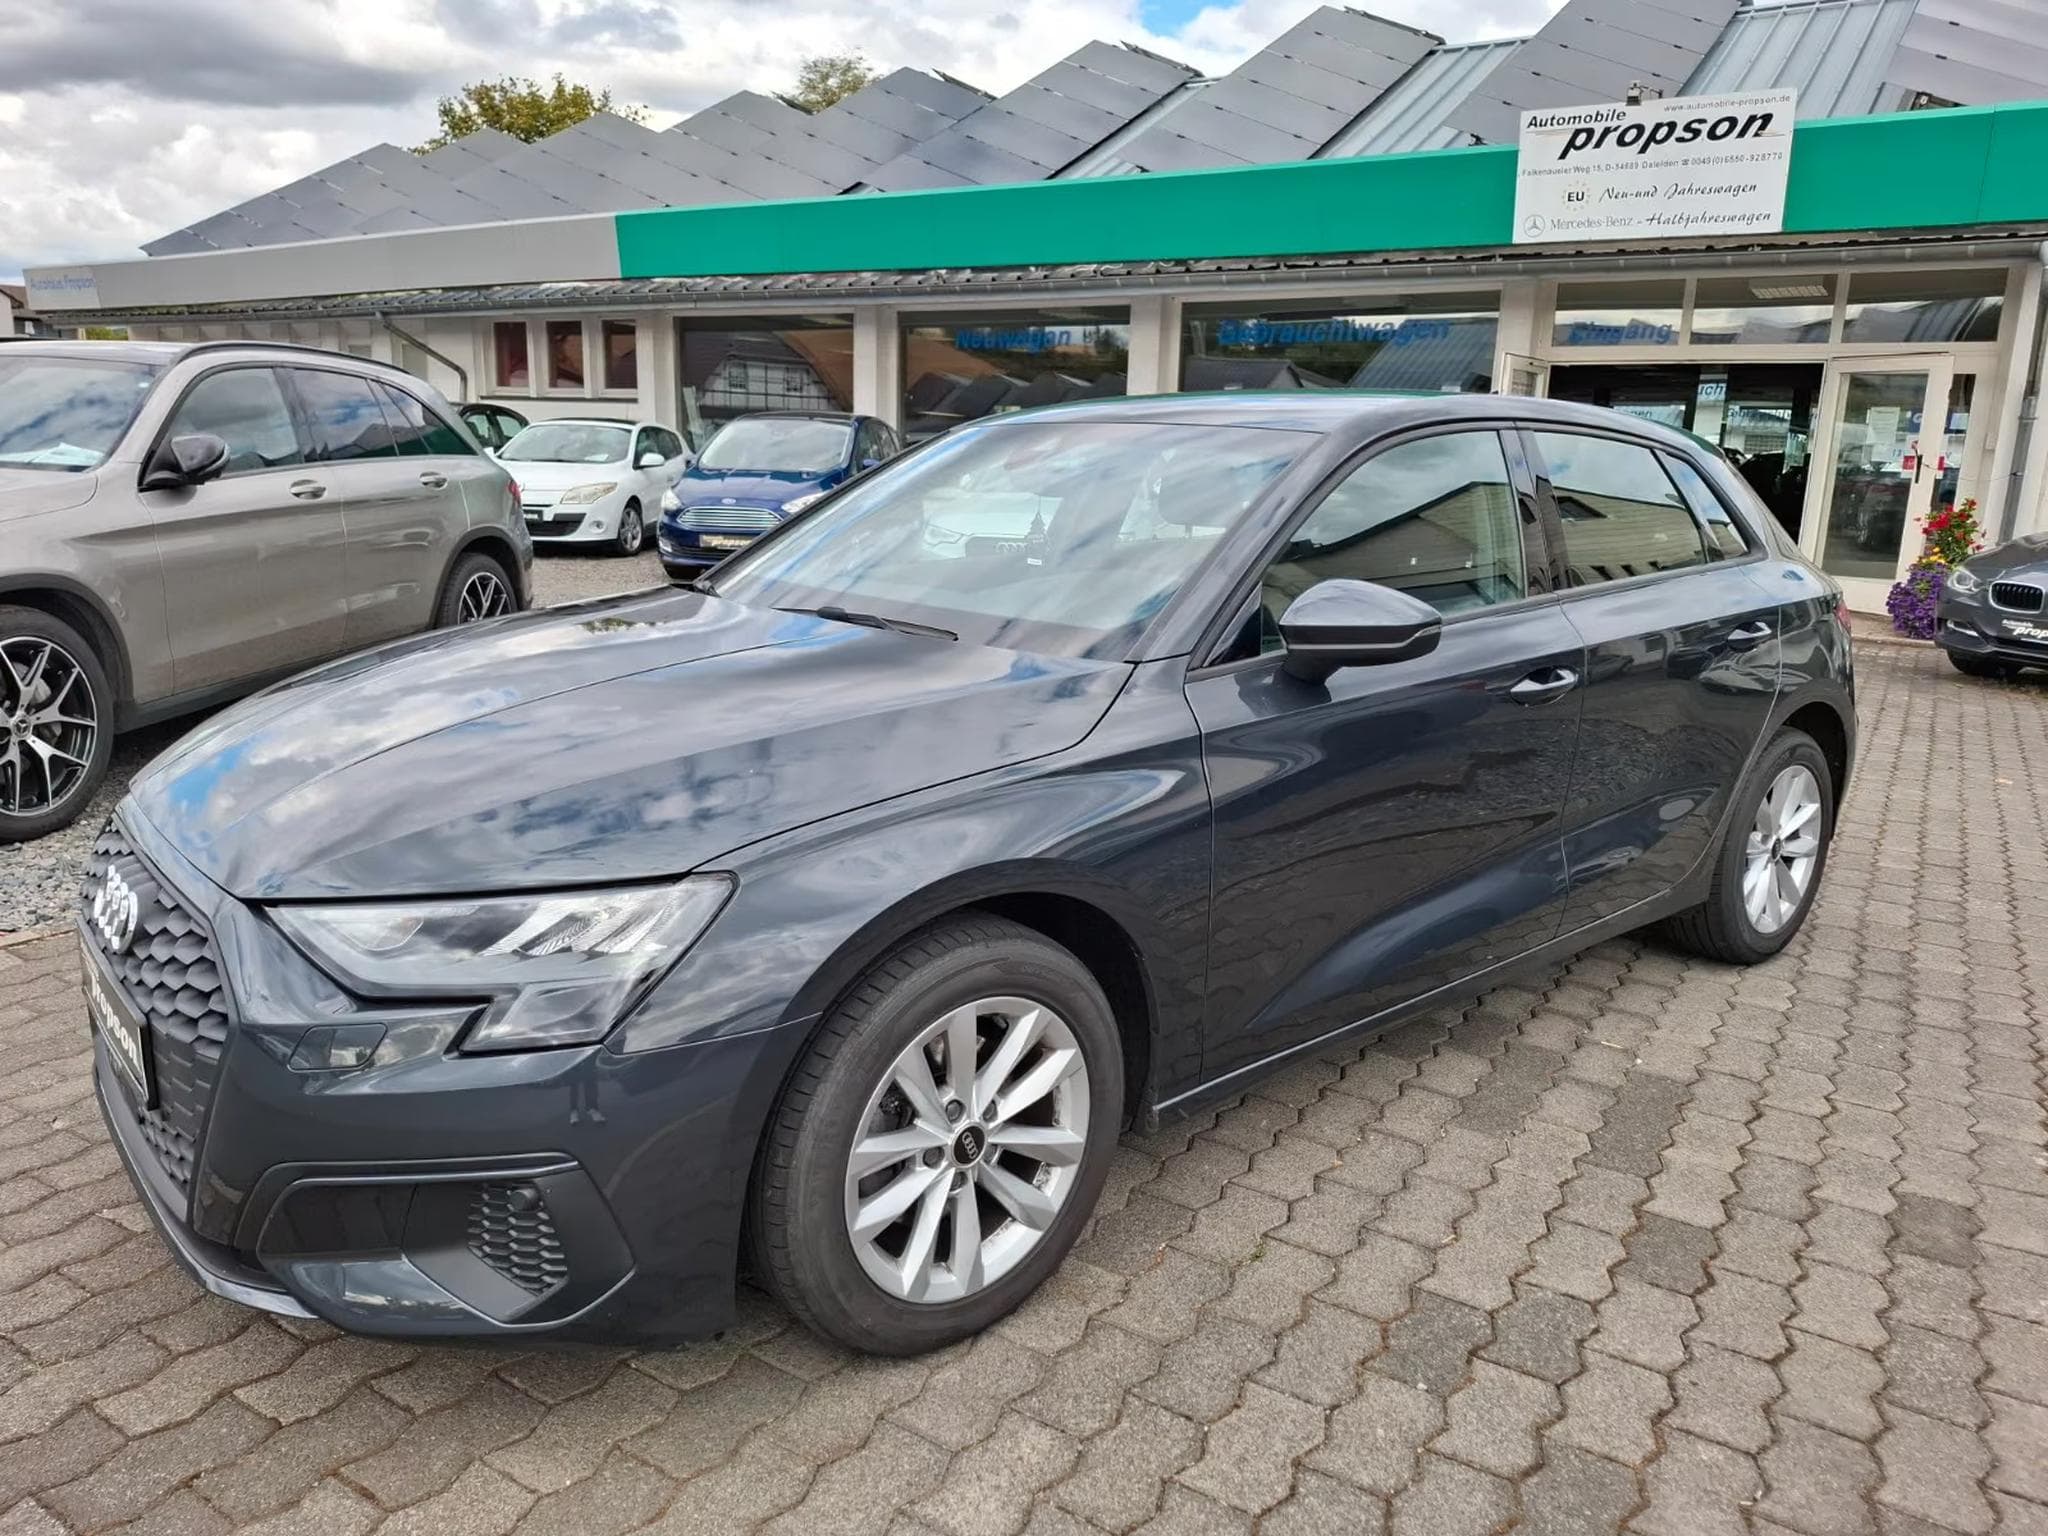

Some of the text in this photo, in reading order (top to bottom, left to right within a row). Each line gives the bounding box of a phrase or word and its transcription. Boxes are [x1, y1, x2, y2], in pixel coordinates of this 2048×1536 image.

[1663, 95, 1791, 112] www.automobile-propson.de
[1527, 108, 1627, 129] Automobile
[1557, 111, 1775, 160] propson
[1567, 191, 1585, 202] EU
[1663, 182, 1758, 200] Jahreswagen
[1550, 215, 1634, 231] Mercedes-Benz
[956, 327, 1072, 354] Neuwagen
[1217, 316, 1451, 346] Gebrauchtwagen
[1567, 324, 1673, 345] Eingang
